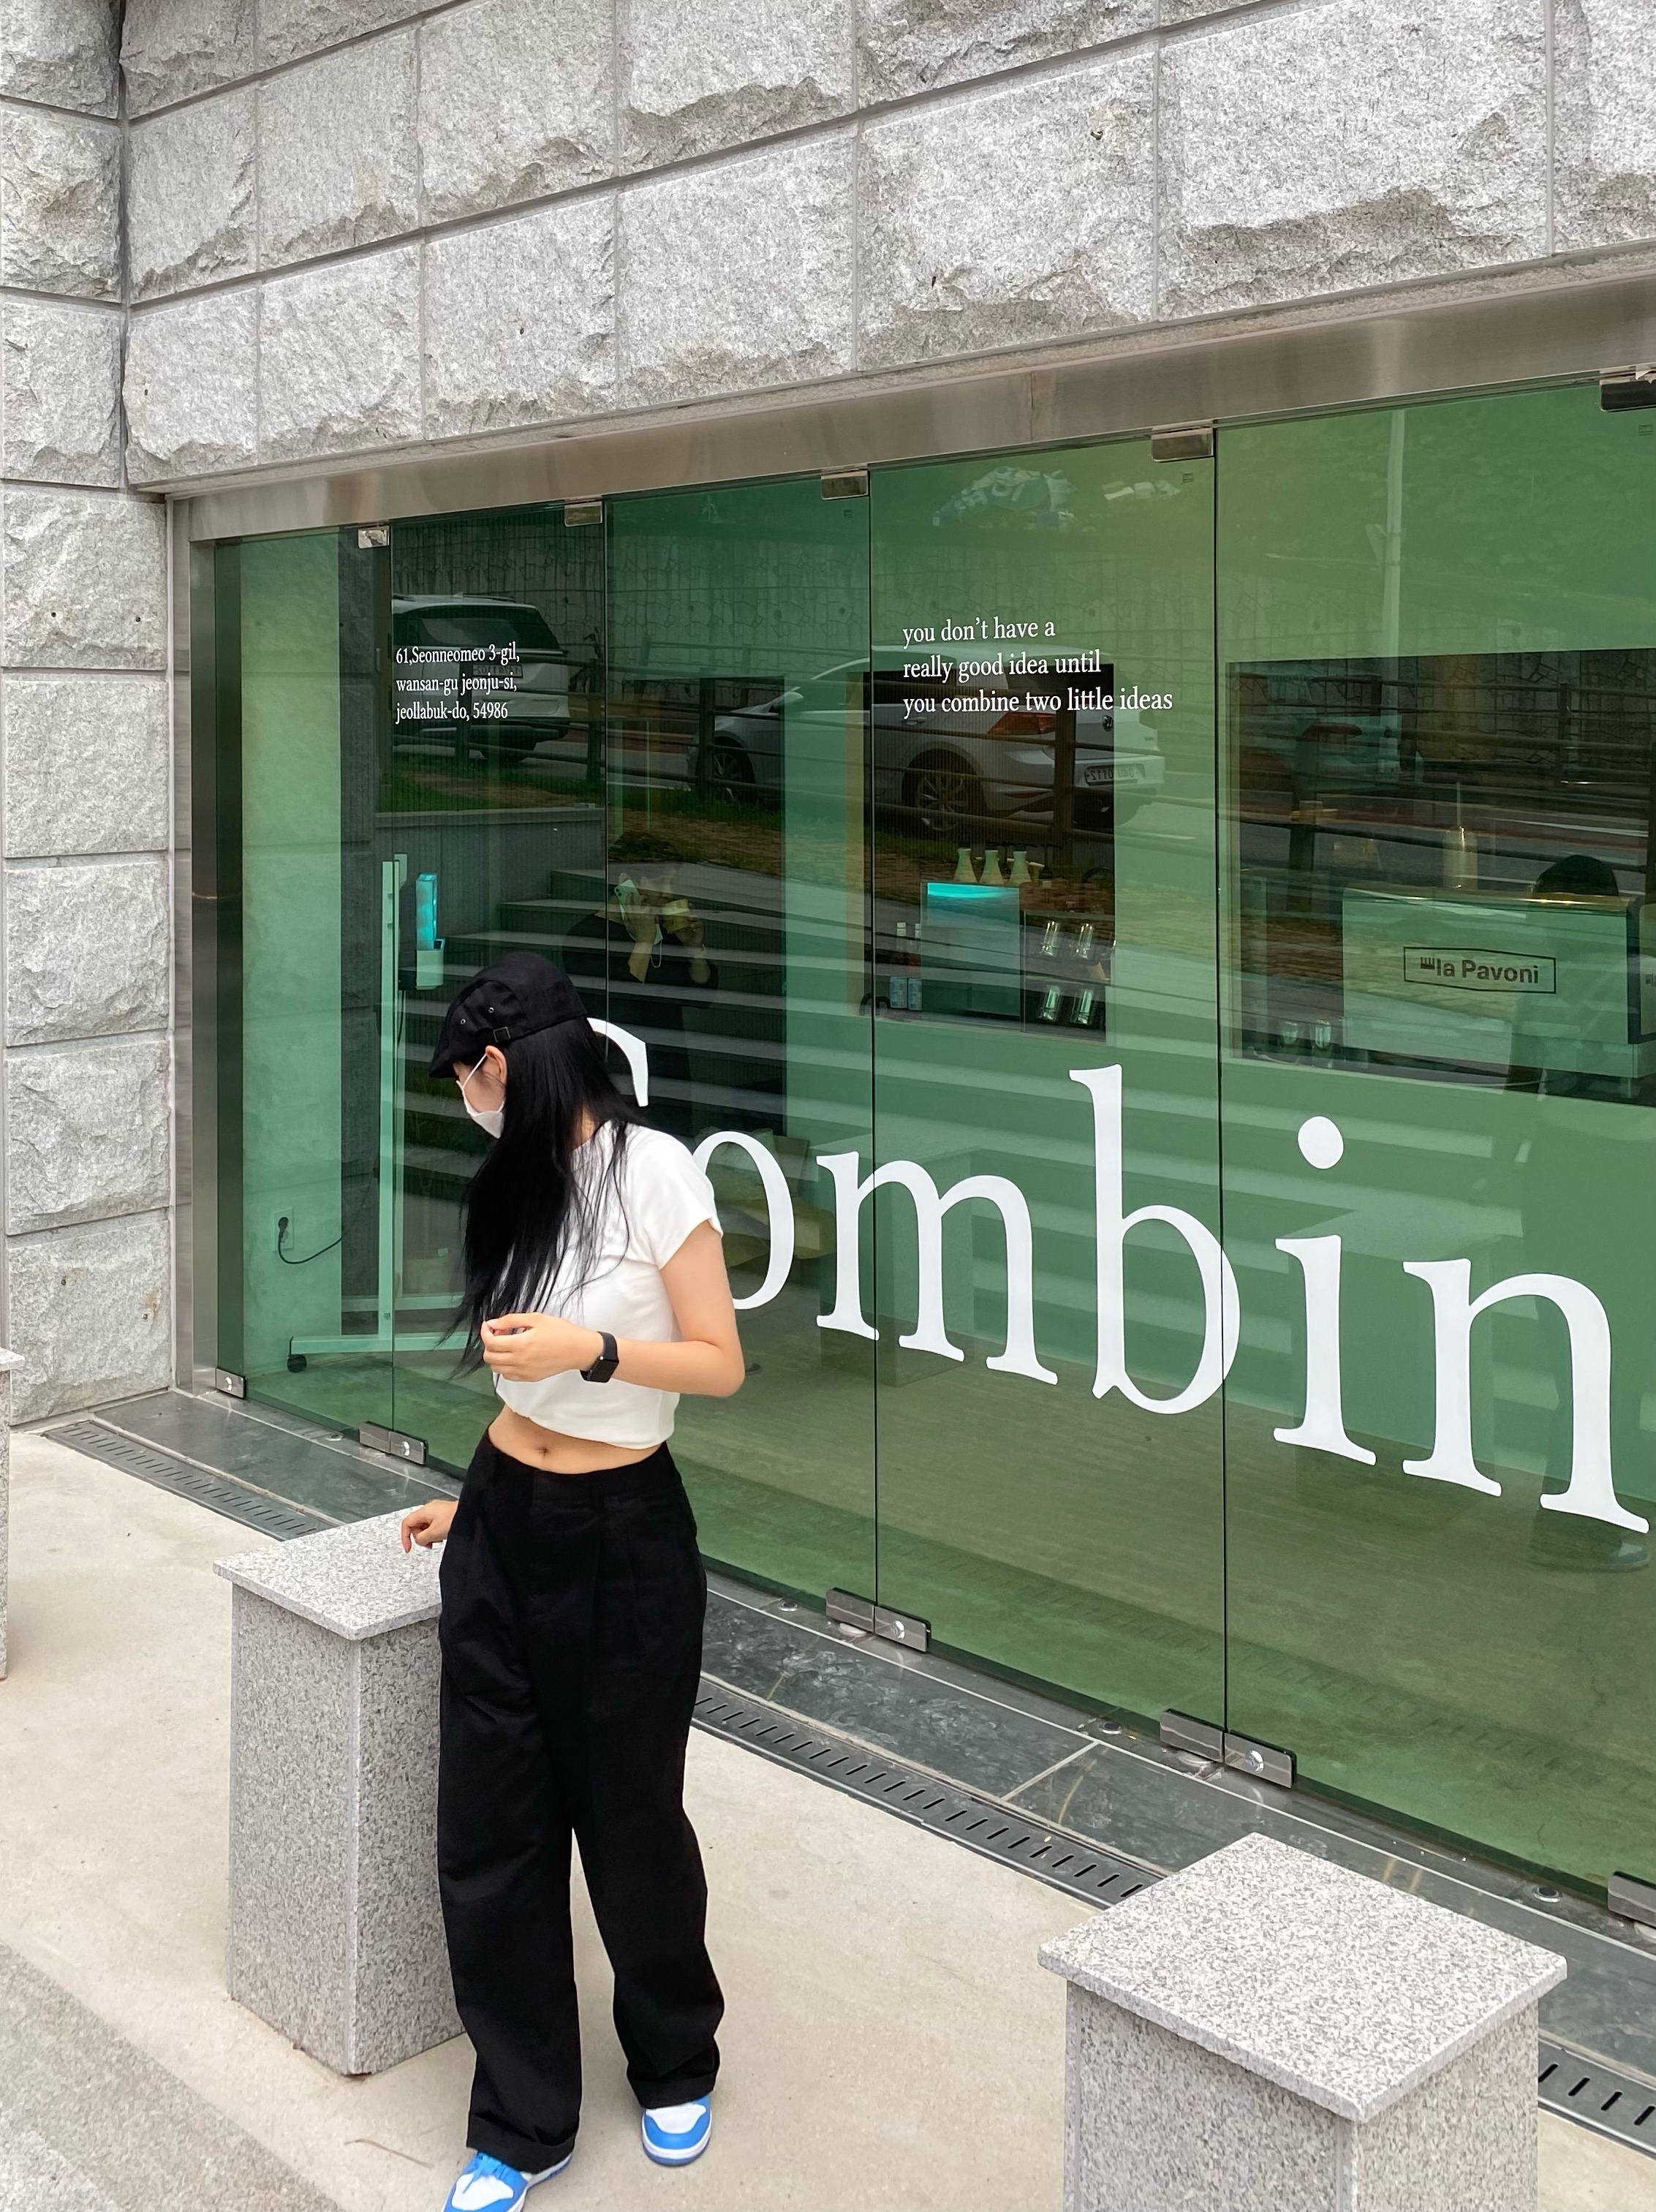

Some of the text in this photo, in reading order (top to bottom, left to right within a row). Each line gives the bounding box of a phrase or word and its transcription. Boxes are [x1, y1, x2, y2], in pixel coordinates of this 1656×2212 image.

[902, 627, 936, 650] you
[993, 616, 1038, 639] have
[1044, 622, 1056, 637] a
[488, 641, 520, 666] 3-gil,
[903, 649, 1102, 684] really good idea until
[396, 671, 517, 696] wansan-gu jeonju-si,
[395, 701, 508, 725] jeollabuk-do, 54986
[903, 685, 1173, 720] you combine two little ideas
[1437, 958, 1538, 984] la Pavoni
[587, 1016, 1649, 1533] ombin
